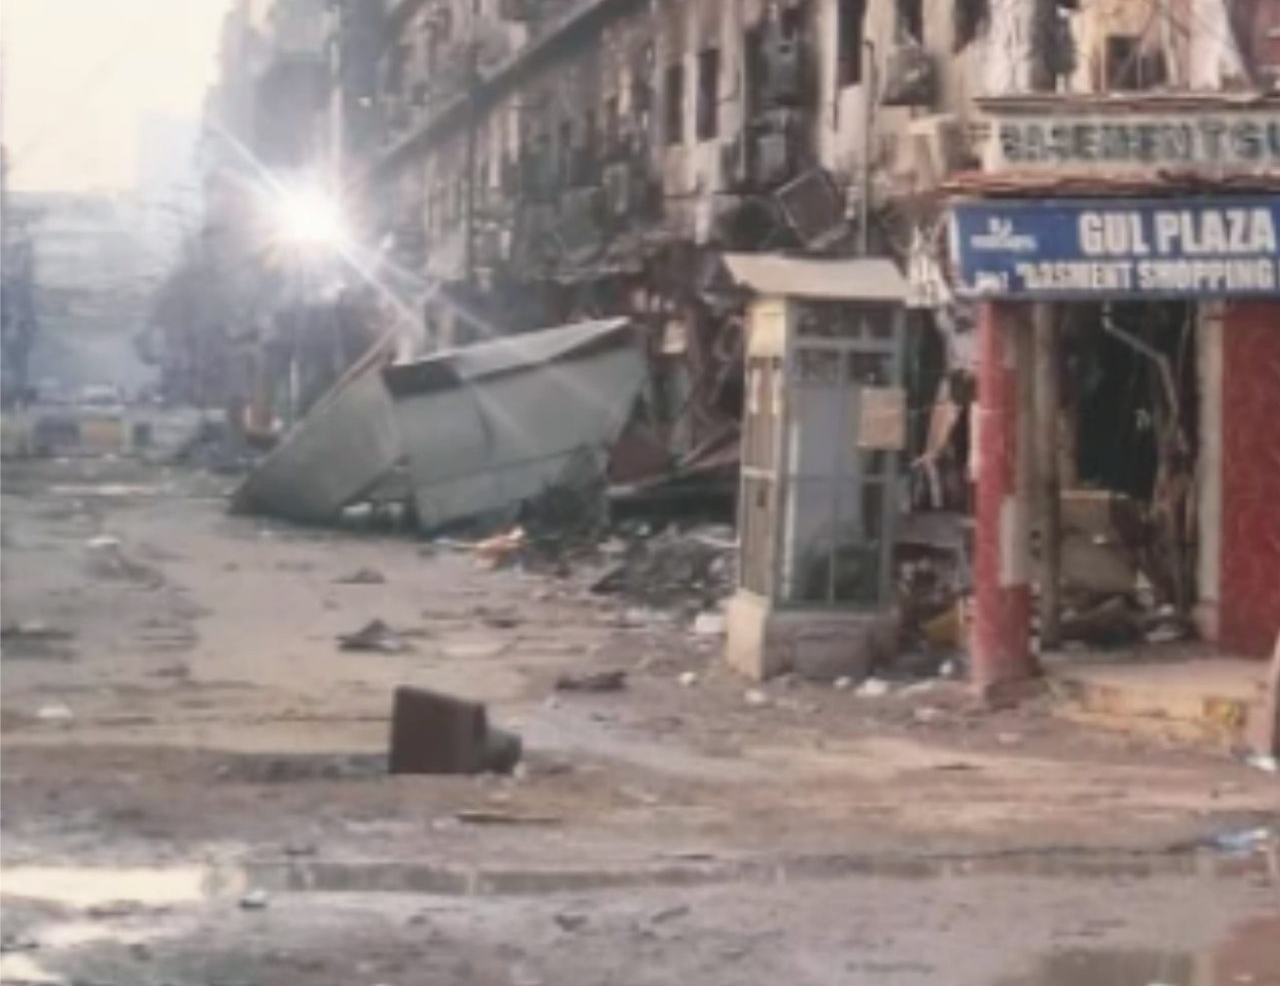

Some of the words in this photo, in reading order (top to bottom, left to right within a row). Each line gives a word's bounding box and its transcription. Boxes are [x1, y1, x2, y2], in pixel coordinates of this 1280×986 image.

[1078, 210, 1150, 254] GUL
[1154, 207, 1278, 254] PLAZA
[1136, 258, 1276, 290] SHOPPING
